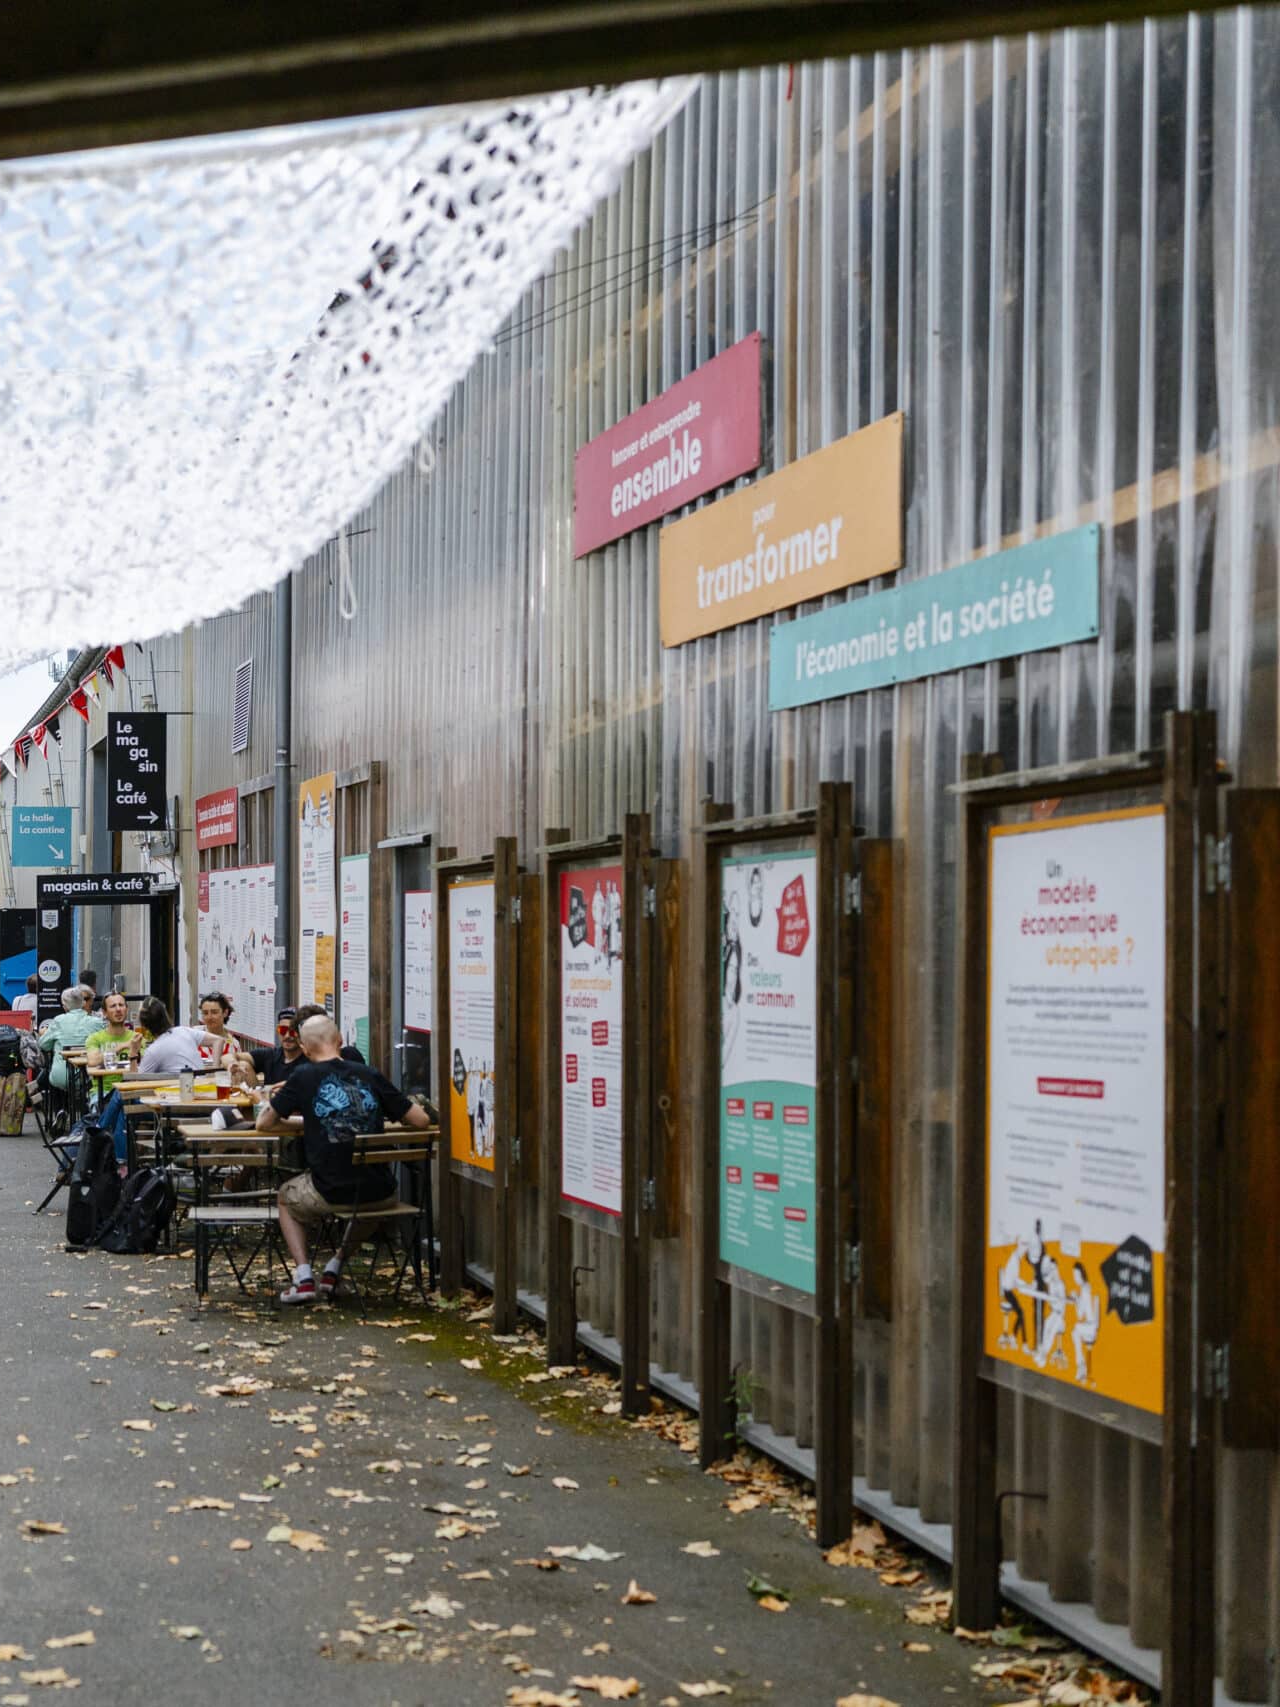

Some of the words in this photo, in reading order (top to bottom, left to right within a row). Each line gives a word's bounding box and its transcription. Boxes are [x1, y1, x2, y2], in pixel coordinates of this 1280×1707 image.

[640, 431, 648, 451] et
[649, 400, 701, 445] entreprendre
[611, 430, 701, 517] ensemble
[753, 503, 776, 534] pour
[697, 515, 843, 608] transformer
[796, 617, 899, 680] l'économie
[904, 610, 926, 652] et
[932, 602, 953, 645] la
[960, 568, 1055, 638] société
[116, 721, 133, 734] Le
[116, 736, 139, 746] ma
[129, 748, 148, 761] ga
[138, 760, 158, 772] sin
[117, 779, 133, 792] Le
[116, 792, 147, 804] café
[20, 813, 30, 822] La
[32, 813, 55, 822] halle
[20, 826, 30, 834] La
[32, 826, 65, 834] cantine
[1046, 859, 1062, 878] Un
[43, 879, 99, 894] magasin
[102, 879, 112, 890] &
[114, 878, 144, 890] café
[1038, 876, 1096, 904] modèle
[1021, 908, 1118, 941] économique
[1046, 938, 1119, 973] utopique
[1125, 936, 1135, 966] ?
[756, 992, 795, 1008] commun
